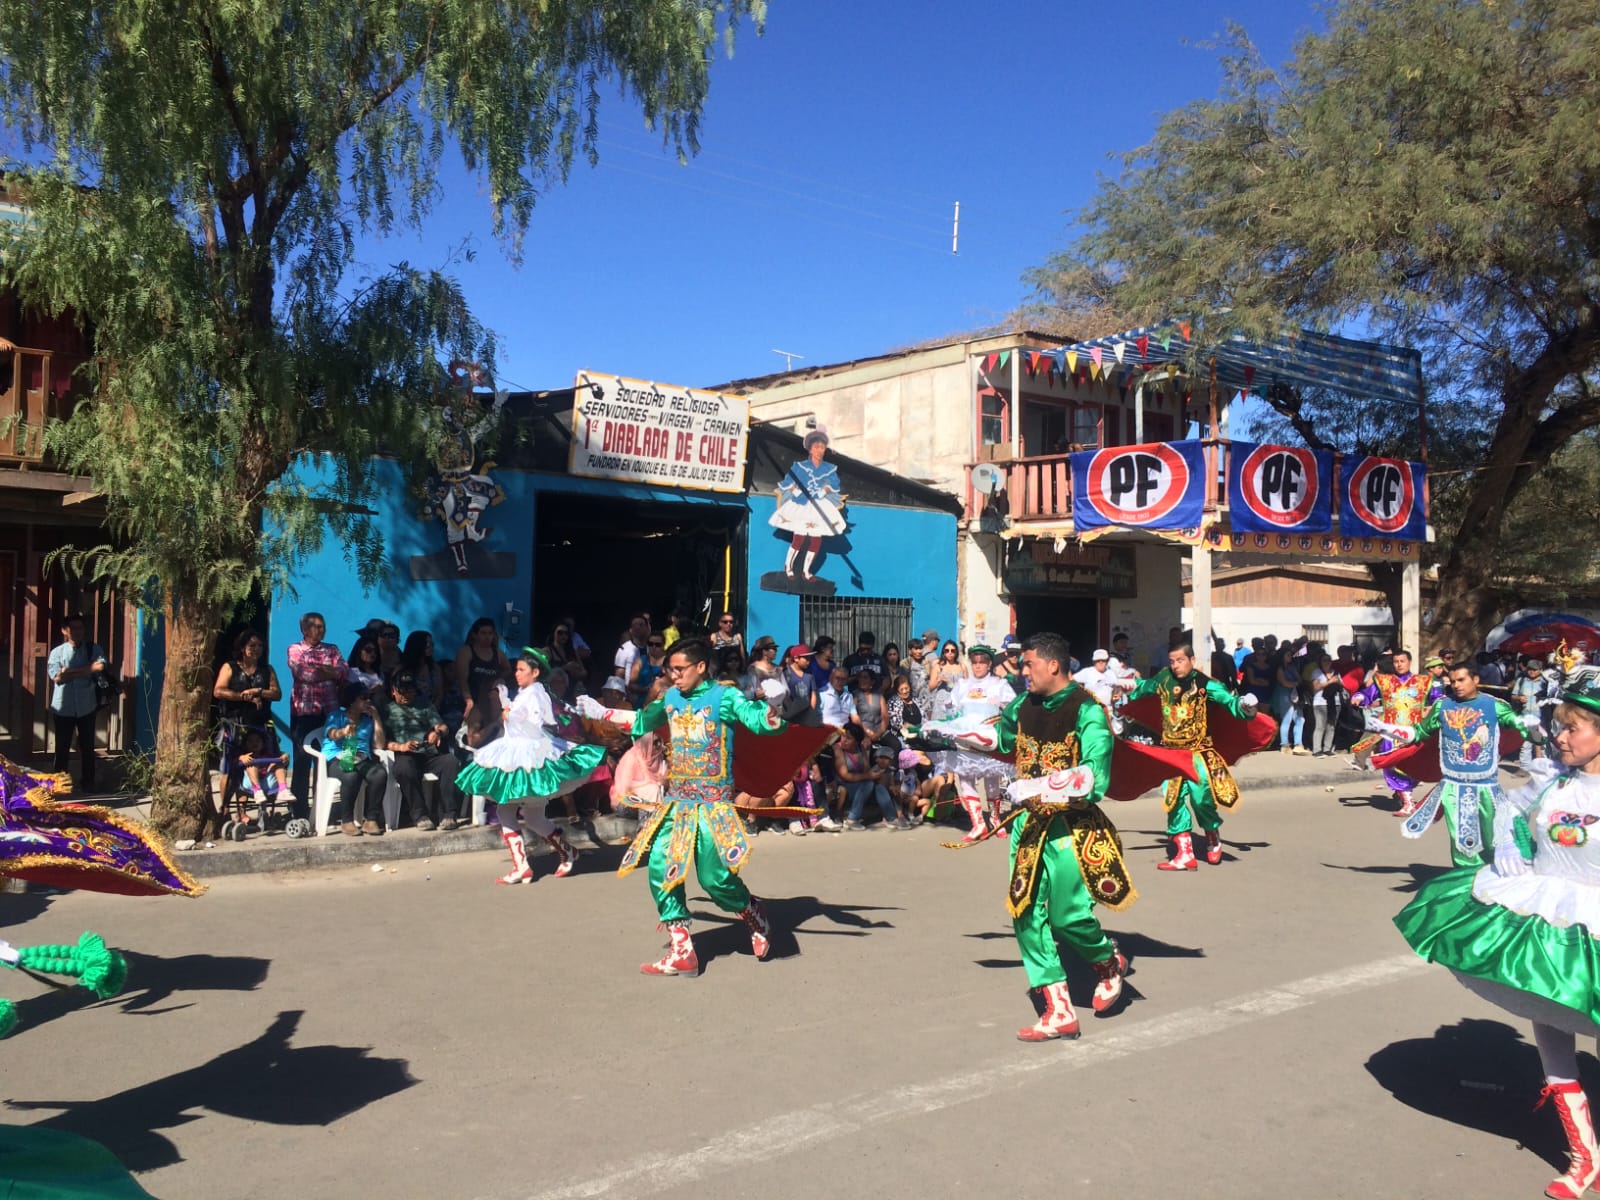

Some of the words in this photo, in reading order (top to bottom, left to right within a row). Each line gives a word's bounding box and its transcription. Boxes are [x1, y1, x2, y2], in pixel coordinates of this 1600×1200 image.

[583, 401, 649, 422] SERVIDORES
[658, 411, 694, 429] VIRGEN
[703, 418, 742, 436] CARMEN
[615, 387, 666, 408] SOCIEDAD
[669, 396, 720, 416] RELIGIOSA
[602, 420, 670, 459] DIABLADA
[674, 431, 693, 462] DE
[699, 434, 738, 468] CHILE
[631, 460, 659, 475] IQUIQUE
[659, 463, 668, 476] EL
[677, 465, 688, 478] DE
[687, 467, 707, 480] JULIO
[707, 469, 718, 481] DE
[1109, 454, 1162, 508] PF
[1261, 453, 1302, 510] PF
[1366, 465, 1401, 517] PF
